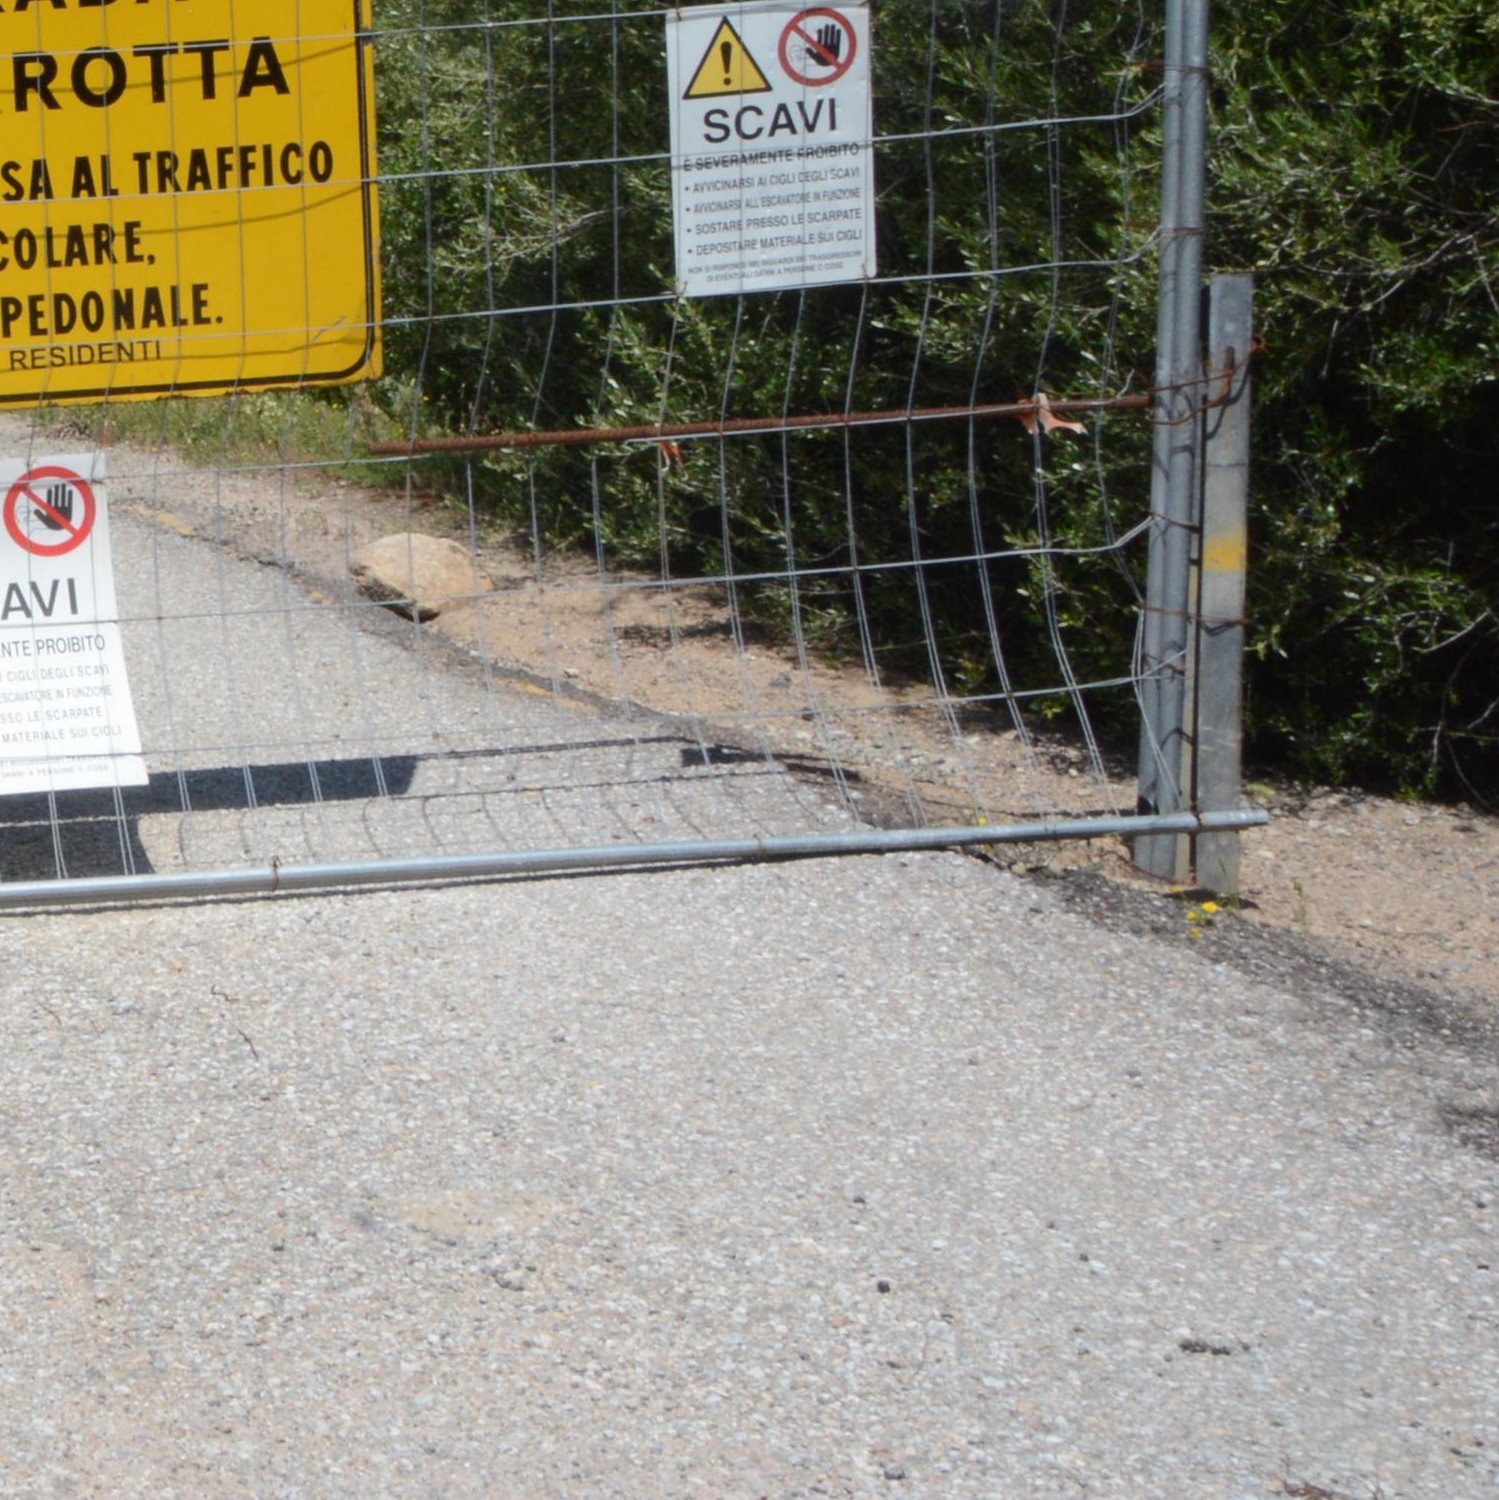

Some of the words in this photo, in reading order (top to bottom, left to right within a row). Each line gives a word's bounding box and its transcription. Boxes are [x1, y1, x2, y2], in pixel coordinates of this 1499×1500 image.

[704, 98, 836, 143] SCAVI
[71, 155, 120, 199] AL
[133, 140, 333, 194] TRAFFICO
[695, 149, 793, 170] SEVERAMENTE
[797, 142, 859, 161] PROIBITO
[693, 177, 755, 193] AVVICINARSI
[769, 173, 795, 186] CIGLI
[798, 169, 828, 183] DEGLI
[829, 166, 860, 180] SCAVI
[695, 220, 743, 235] SOSTARE
[746, 215, 789, 230] PRESSO
[791, 214, 803, 226] LE
[807, 208, 861, 224] SCARPATE
[696, 240, 757, 256] DEPOSITARE
[760, 234, 815, 250] MATERIALE
[817, 232, 834, 244] SUI
[836, 230, 862, 242] CIGLI
[0, 283, 224, 338] PEDONALE.
[10, 340, 162, 371] RESIDENTI
[35, 634, 105, 656] PROIBITO
[39, 666, 73, 680] DEGLI
[27, 710, 41, 723] LE
[45, 706, 103, 721] SCARPATE
[1, 728, 65, 744] MATERIALE
[69, 726, 89, 739] SUI
